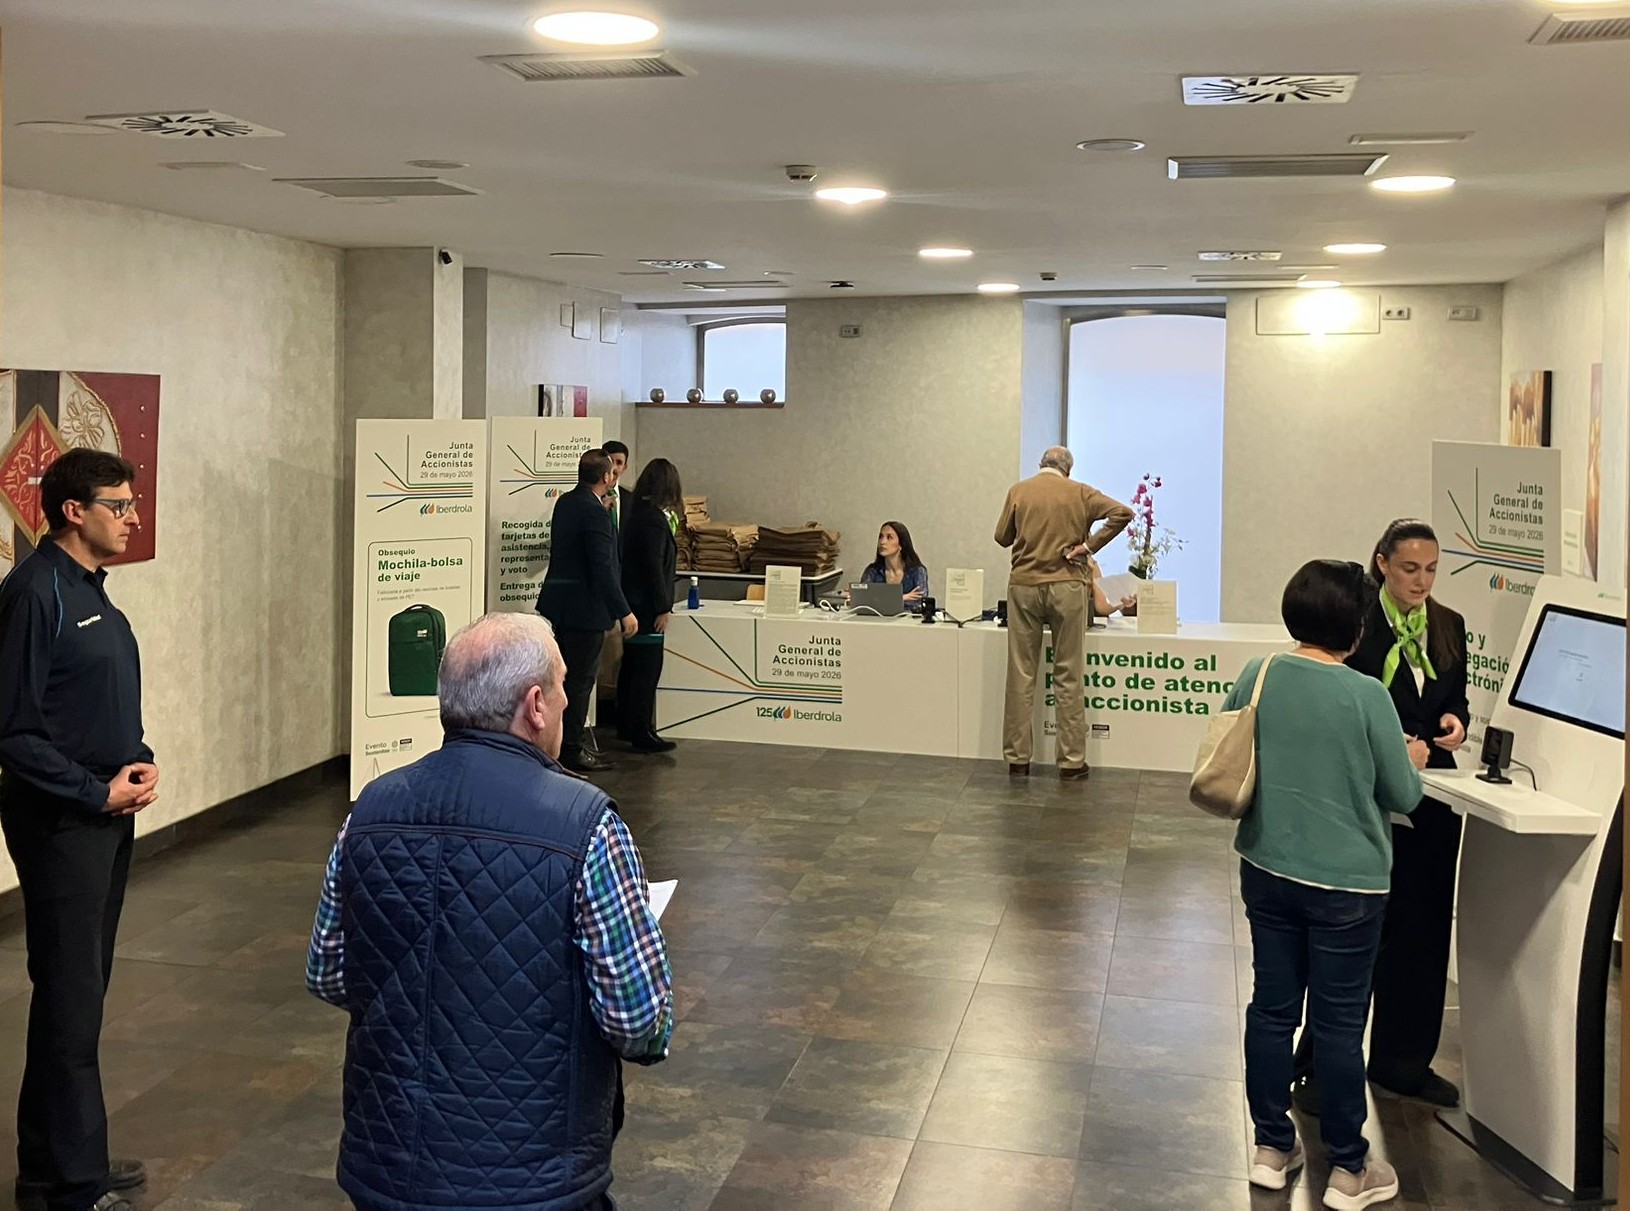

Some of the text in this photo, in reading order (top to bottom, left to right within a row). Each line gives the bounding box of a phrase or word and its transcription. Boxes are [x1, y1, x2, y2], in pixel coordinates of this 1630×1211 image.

[449, 442, 474, 450] Junta
[426, 450, 460, 459] General
[421, 460, 474, 468] Accionistas
[1517, 482, 1543, 496] Junta
[1494, 494, 1543, 510] General de
[436, 504, 473, 514] Iberdrola
[1489, 507, 1543, 525] Accionistas
[502, 520, 543, 530] Recogida
[501, 532, 536, 541] tarjetas
[1489, 525, 1497, 534] 29
[1498, 527, 1506, 535] de
[1507, 528, 1525, 540] mayo
[378, 556, 463, 570] Mochila-bolsa
[500, 554, 549, 564] representa
[378, 571, 420, 582] de viaje
[500, 567, 506, 576] y
[500, 582, 535, 591] Entrega
[1505, 578, 1535, 596] Iberdro
[809, 635, 841, 645] Junta
[1478, 634, 1485, 650] y
[778, 644, 841, 656] General de
[772, 655, 842, 667] Accionistas
[1046, 647, 1216, 671] Bnvenido al
[1467, 652, 1509, 674] egació
[797, 671, 819, 679] mayo
[821, 671, 842, 679] 2026
[1125, 673, 1155, 690] de
[1164, 676, 1233, 694] atenc
[756, 707, 842, 722] 125 Iberdrola
